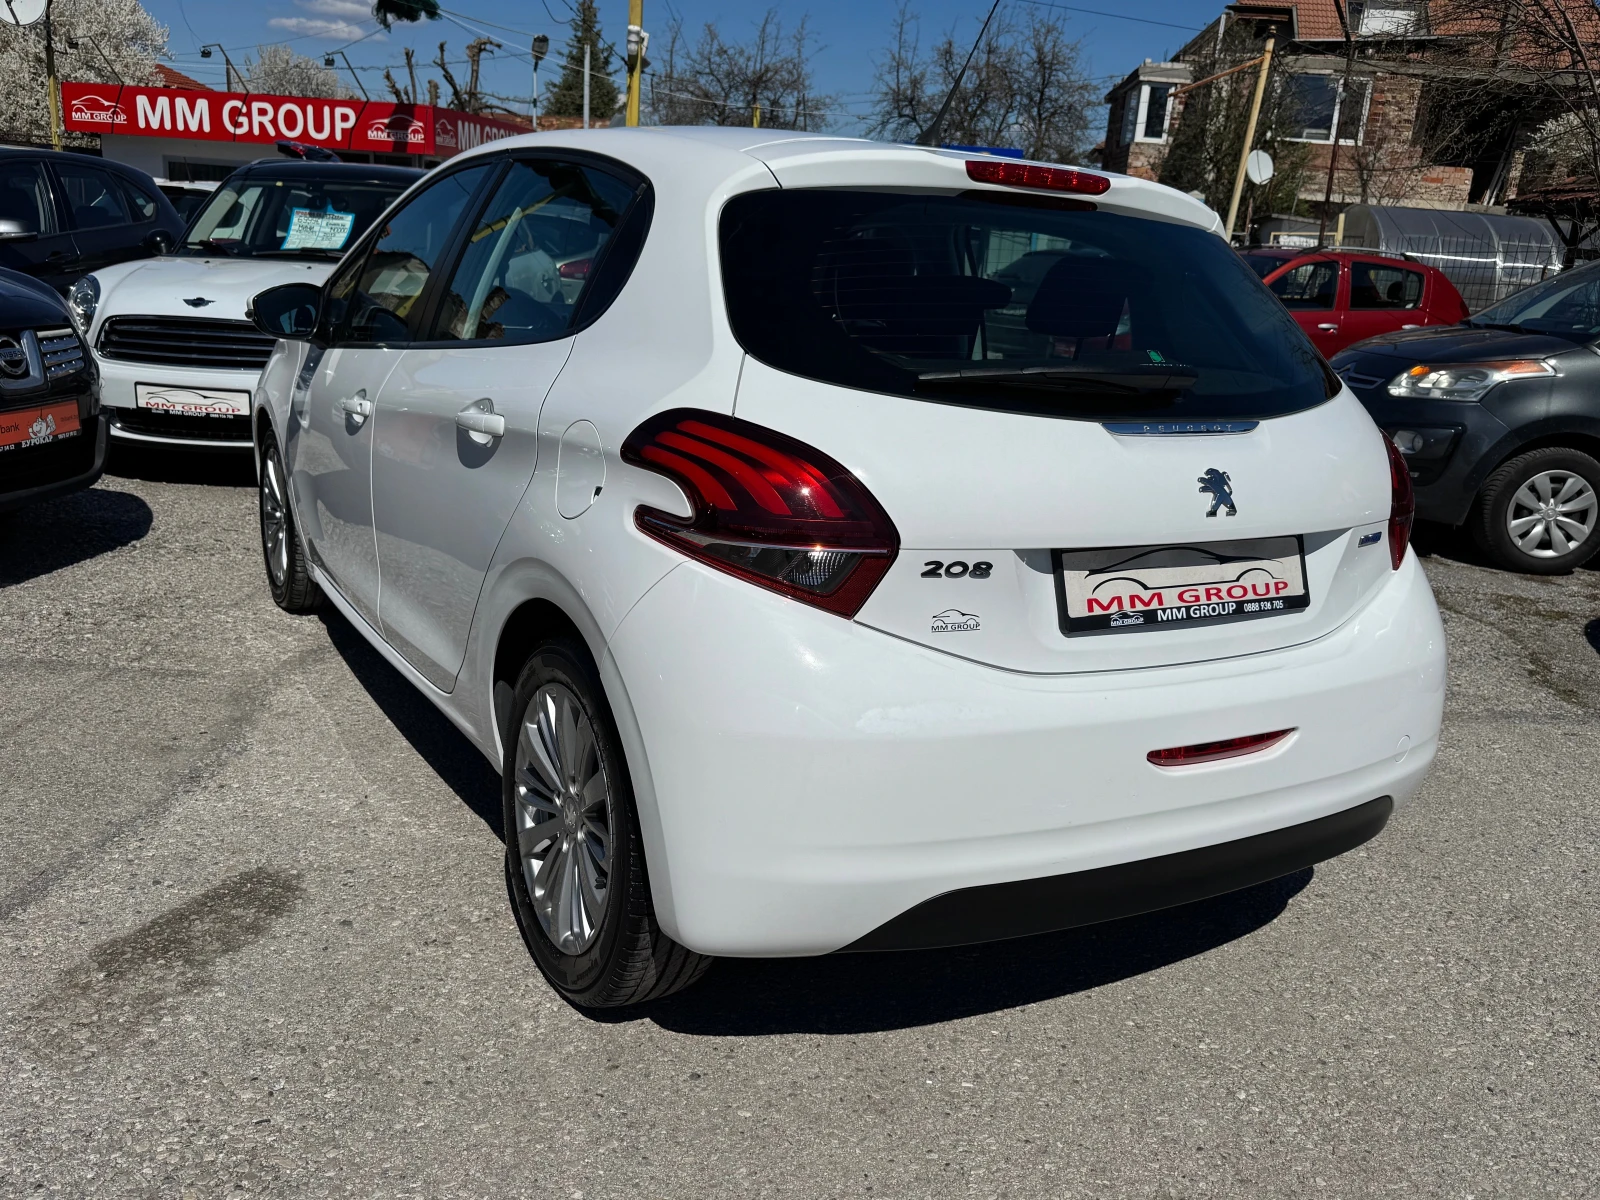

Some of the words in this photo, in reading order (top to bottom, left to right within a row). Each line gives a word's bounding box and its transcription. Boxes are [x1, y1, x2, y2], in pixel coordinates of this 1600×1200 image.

[72, 111, 91, 120] MM
[93, 113, 127, 122] GROUP
[136, 94, 211, 133] MM
[222, 99, 357, 141] GROUP
[368, 130, 388, 139] MM
[390, 132, 425, 141] GROUP
[457, 119, 481, 150] MM
[145, 401, 176, 410] MM
[181, 404, 241, 414] GROUP
[1143, 424, 1232, 433] PEUGEOT
[21, 434, 54, 448] ЕУРОКАР
[920, 560, 994, 580] 208
[1086, 592, 1164, 613] MM
[1177, 581, 1290, 605] GROUP
[1157, 607, 1187, 622] MM
[1189, 602, 1237, 618] GROUP
[1243, 602, 1259, 612] 0888
[1260, 601, 1272, 610] 936
[1272, 600, 1284, 609] 705
[951, 622, 981, 631] GROUP
